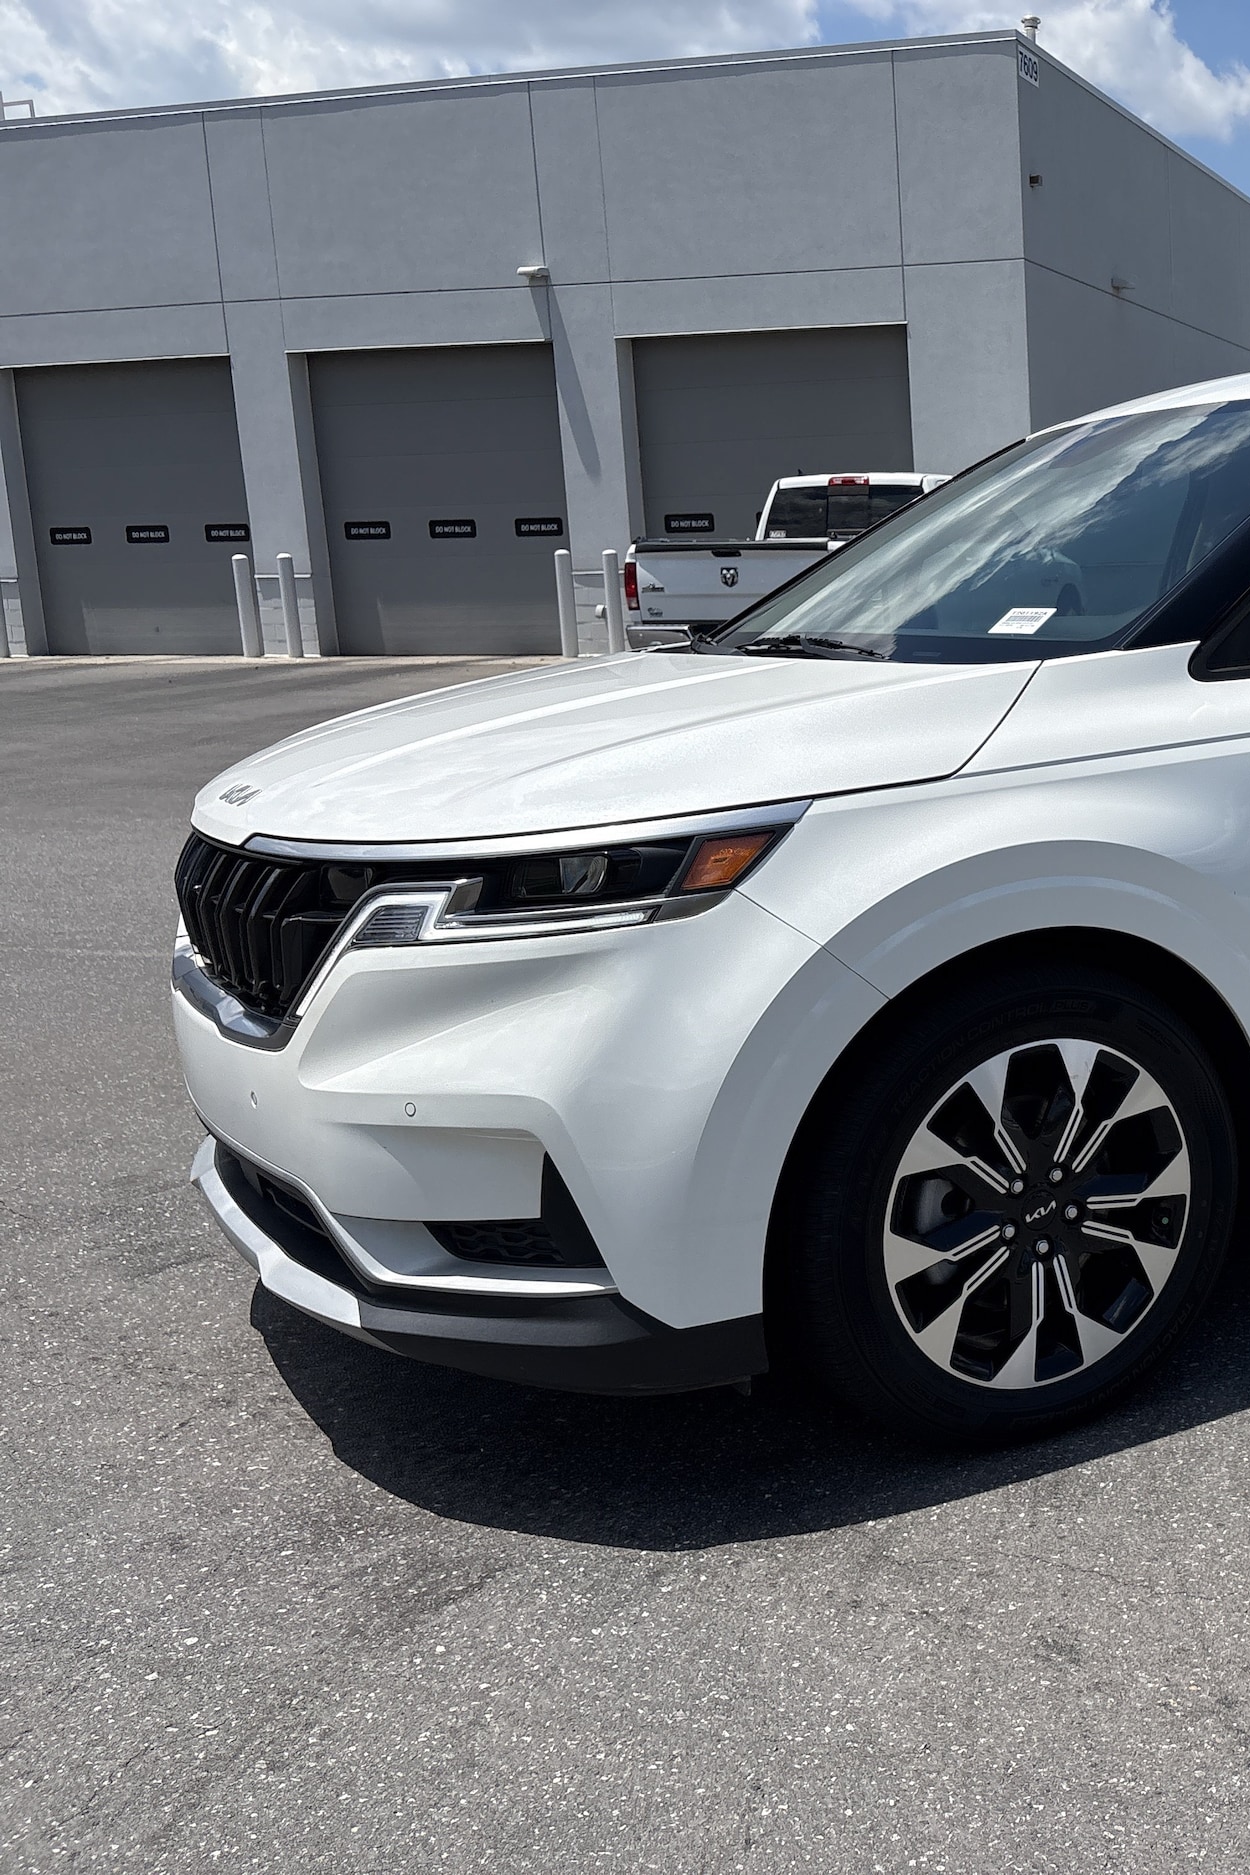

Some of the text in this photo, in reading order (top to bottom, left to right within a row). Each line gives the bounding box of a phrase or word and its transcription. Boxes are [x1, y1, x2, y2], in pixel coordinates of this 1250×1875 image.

[1019, 50, 1038, 82] 7609
[680, 520, 690, 528] NOT
[1054, 998, 1090, 1011] PLUS
